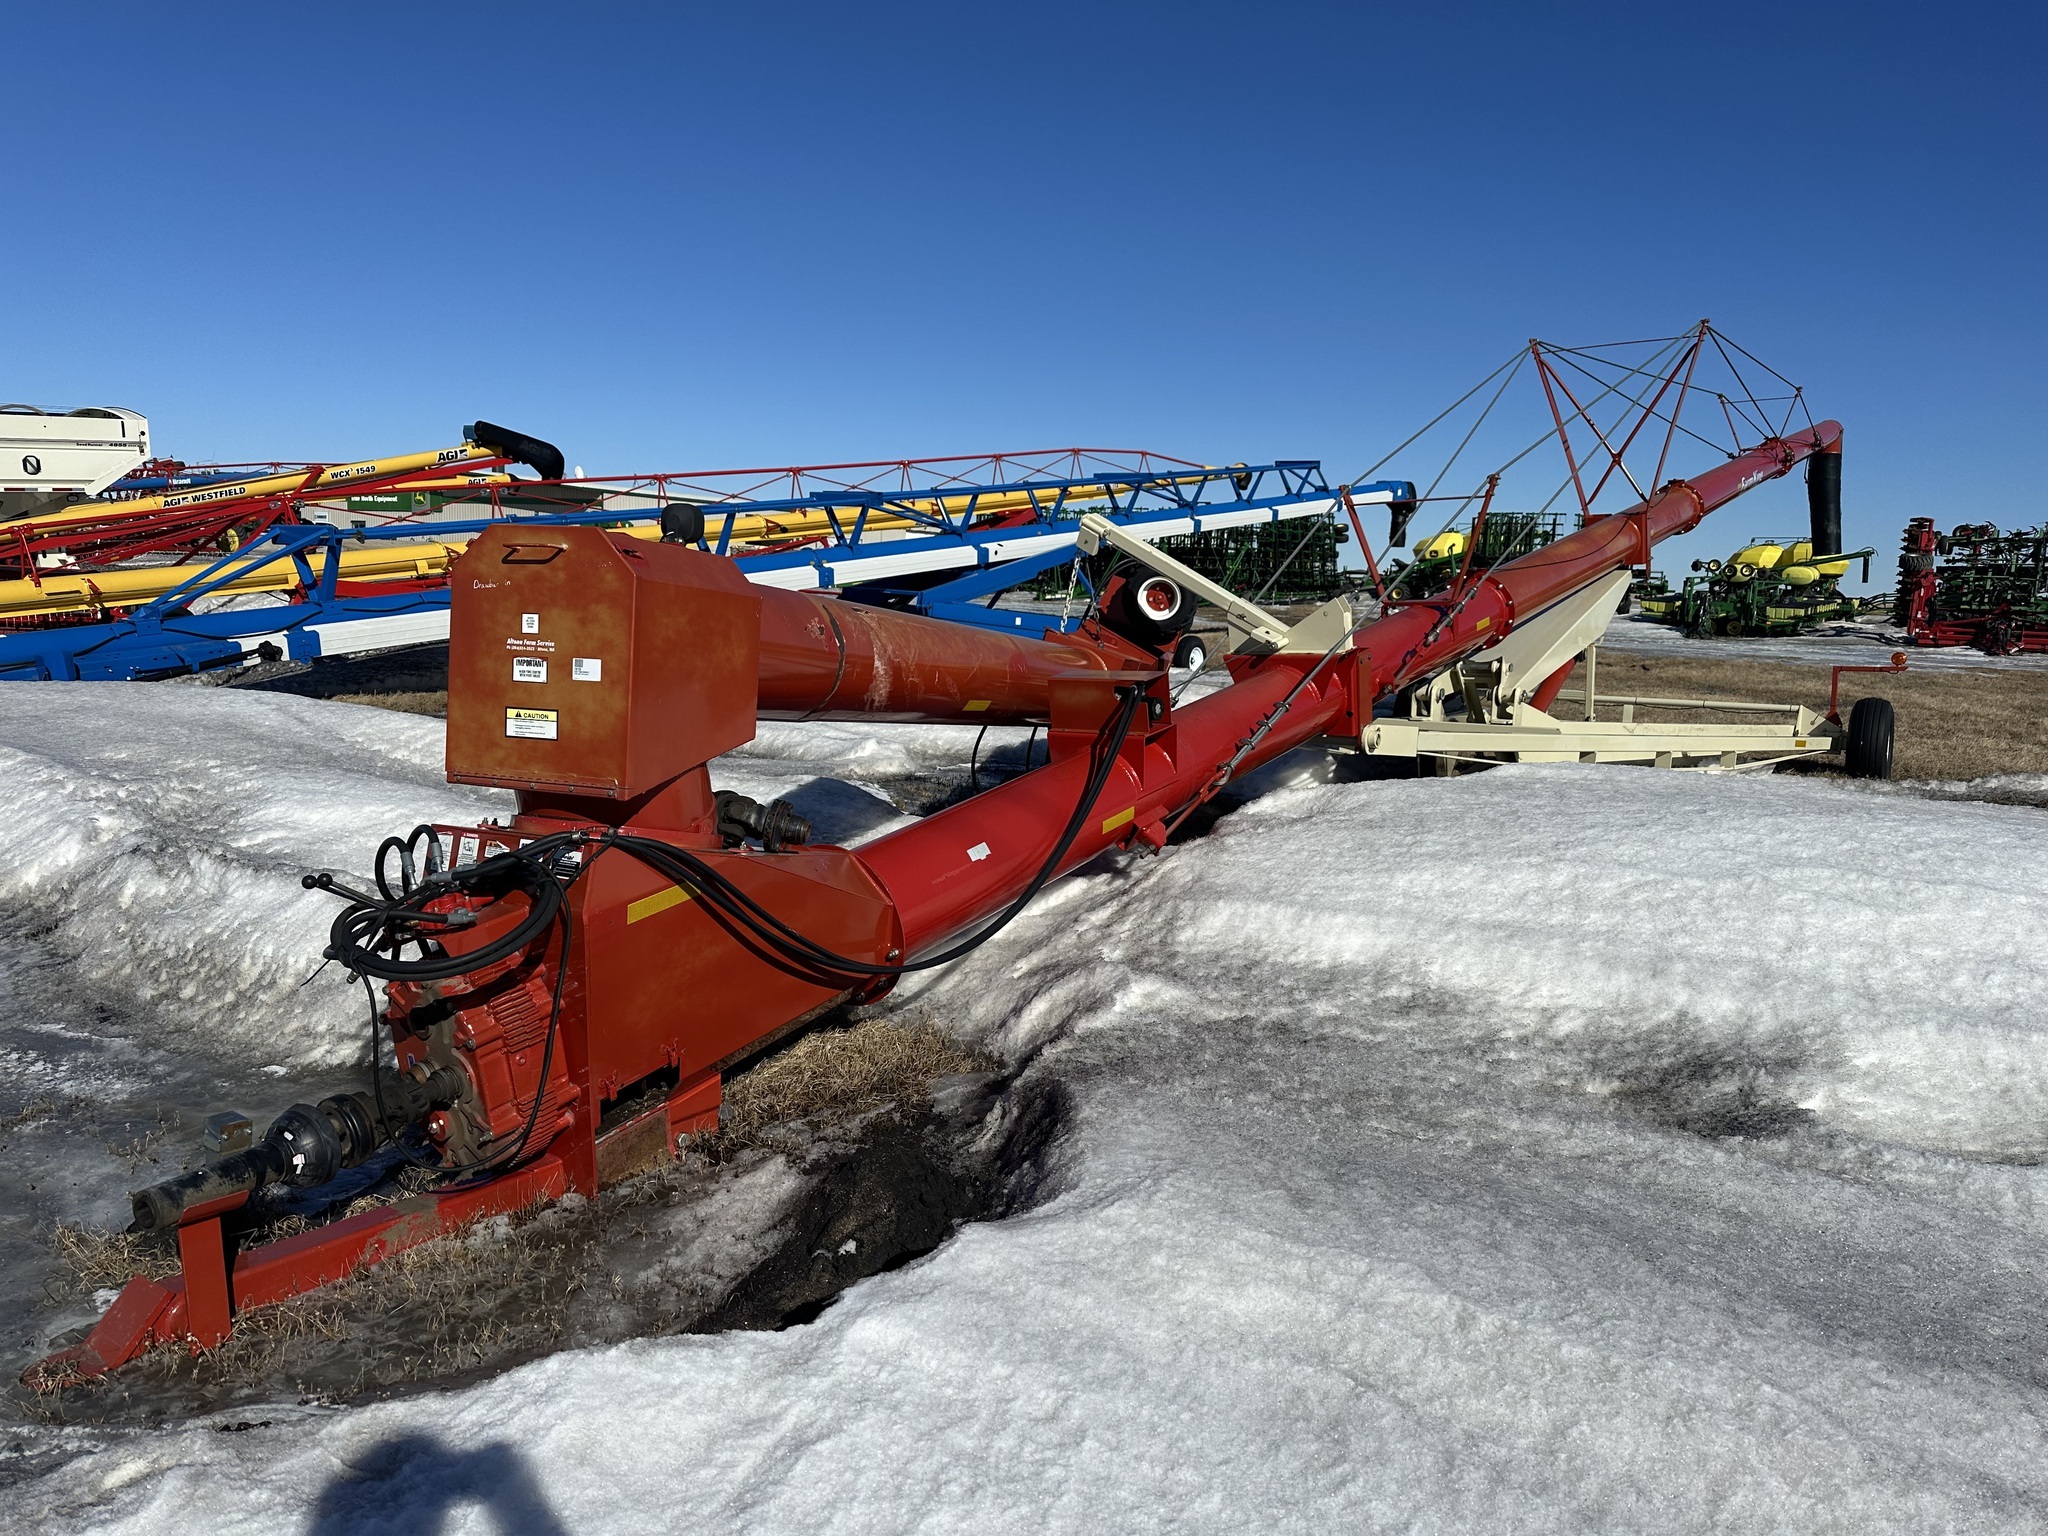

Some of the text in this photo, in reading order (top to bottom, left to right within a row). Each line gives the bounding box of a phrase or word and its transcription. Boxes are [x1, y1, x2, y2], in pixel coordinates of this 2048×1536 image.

[437, 450, 459, 462] AGI
[355, 466, 376, 475] 1549
[163, 487, 246, 508] AGI WESTFIELD
[374, 495, 397, 503] Equipment
[516, 659, 544, 668] IMPORTANT
